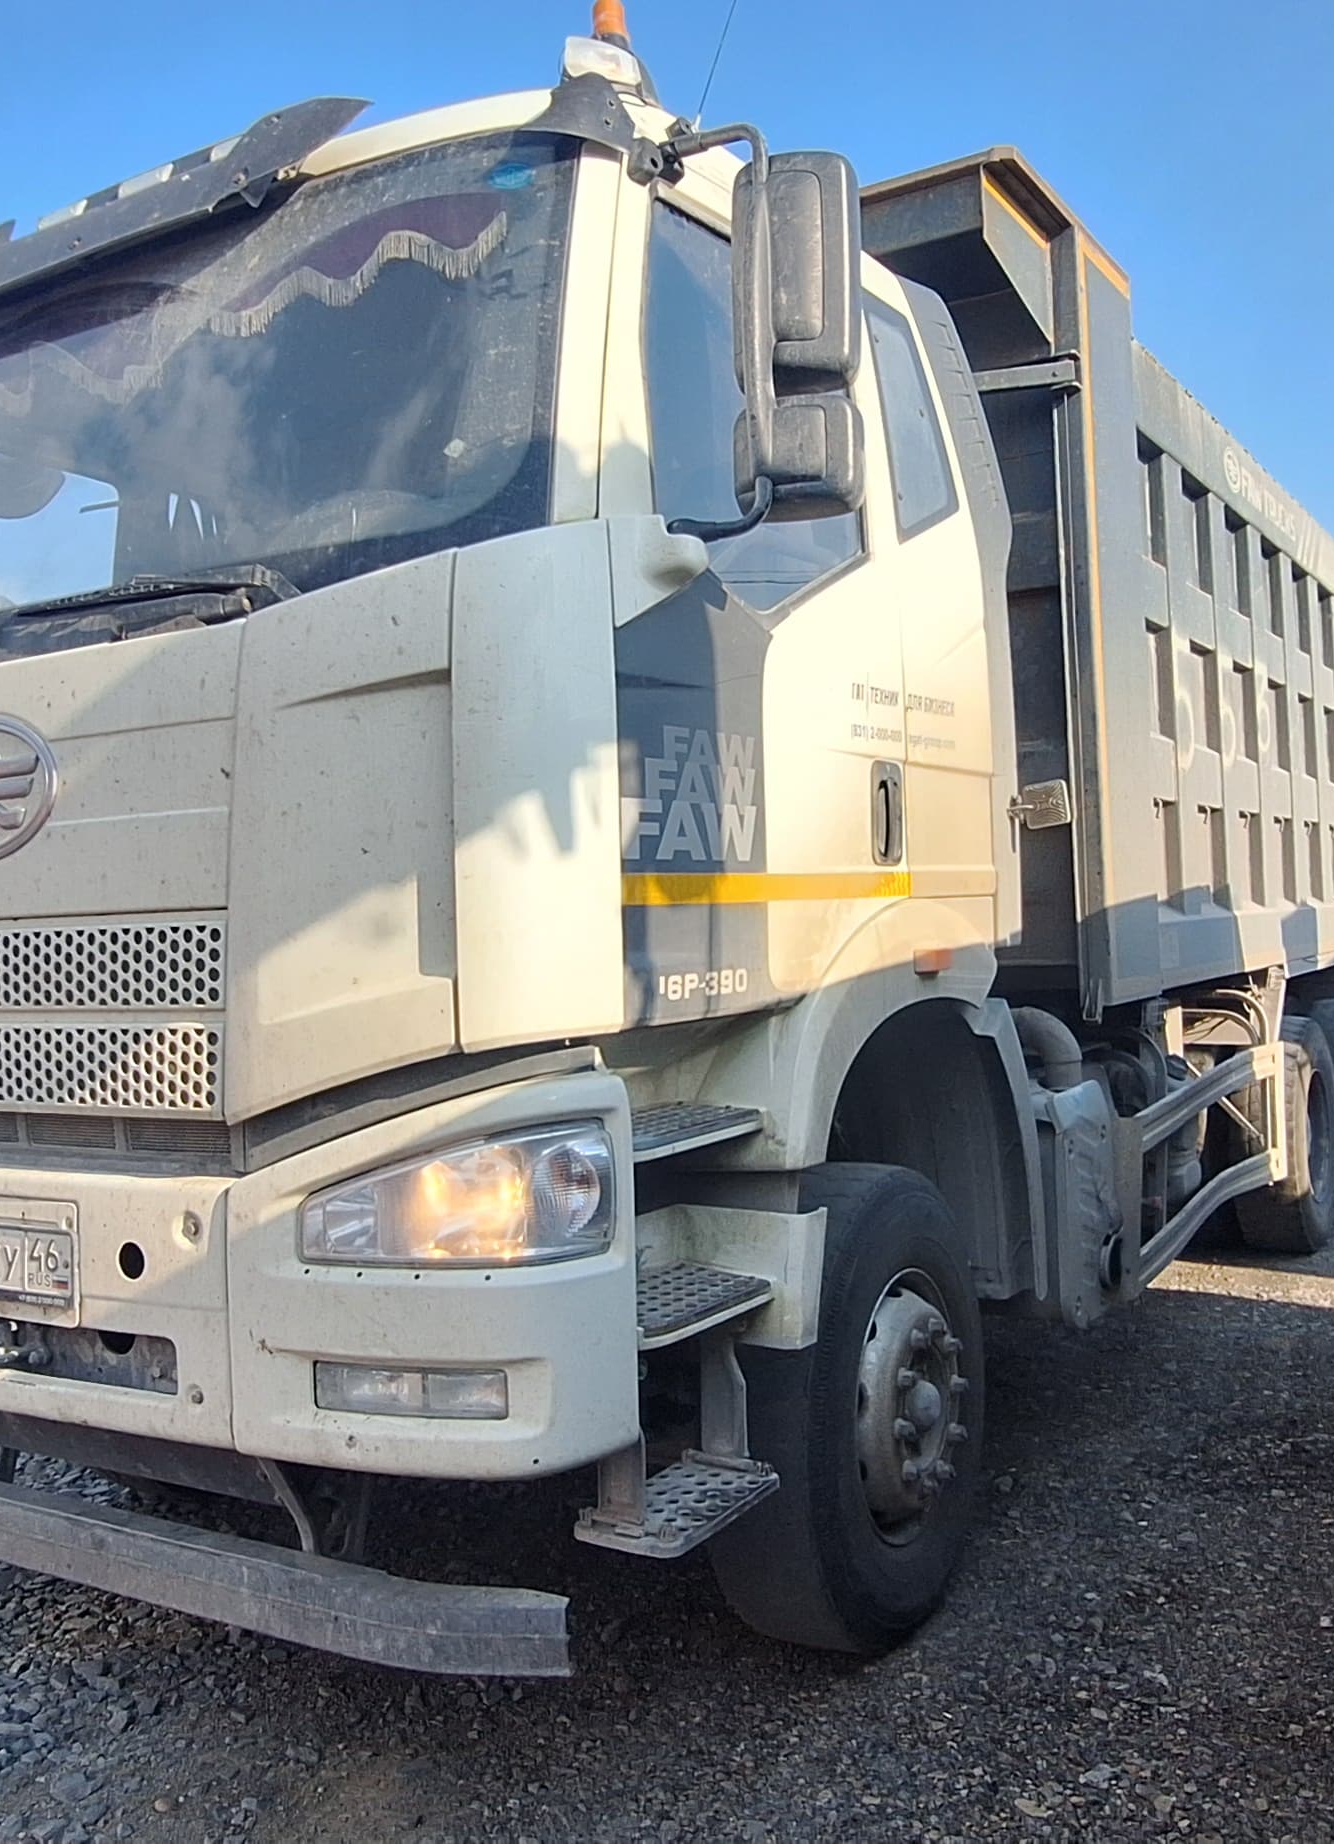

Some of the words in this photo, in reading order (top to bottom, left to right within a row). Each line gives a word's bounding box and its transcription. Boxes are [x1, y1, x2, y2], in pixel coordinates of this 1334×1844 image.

[663, 725, 755, 770] FAW
[645, 757, 755, 814] FAW
[621, 797, 757, 862] FAW
[28, 1273, 53, 1288] RUS
